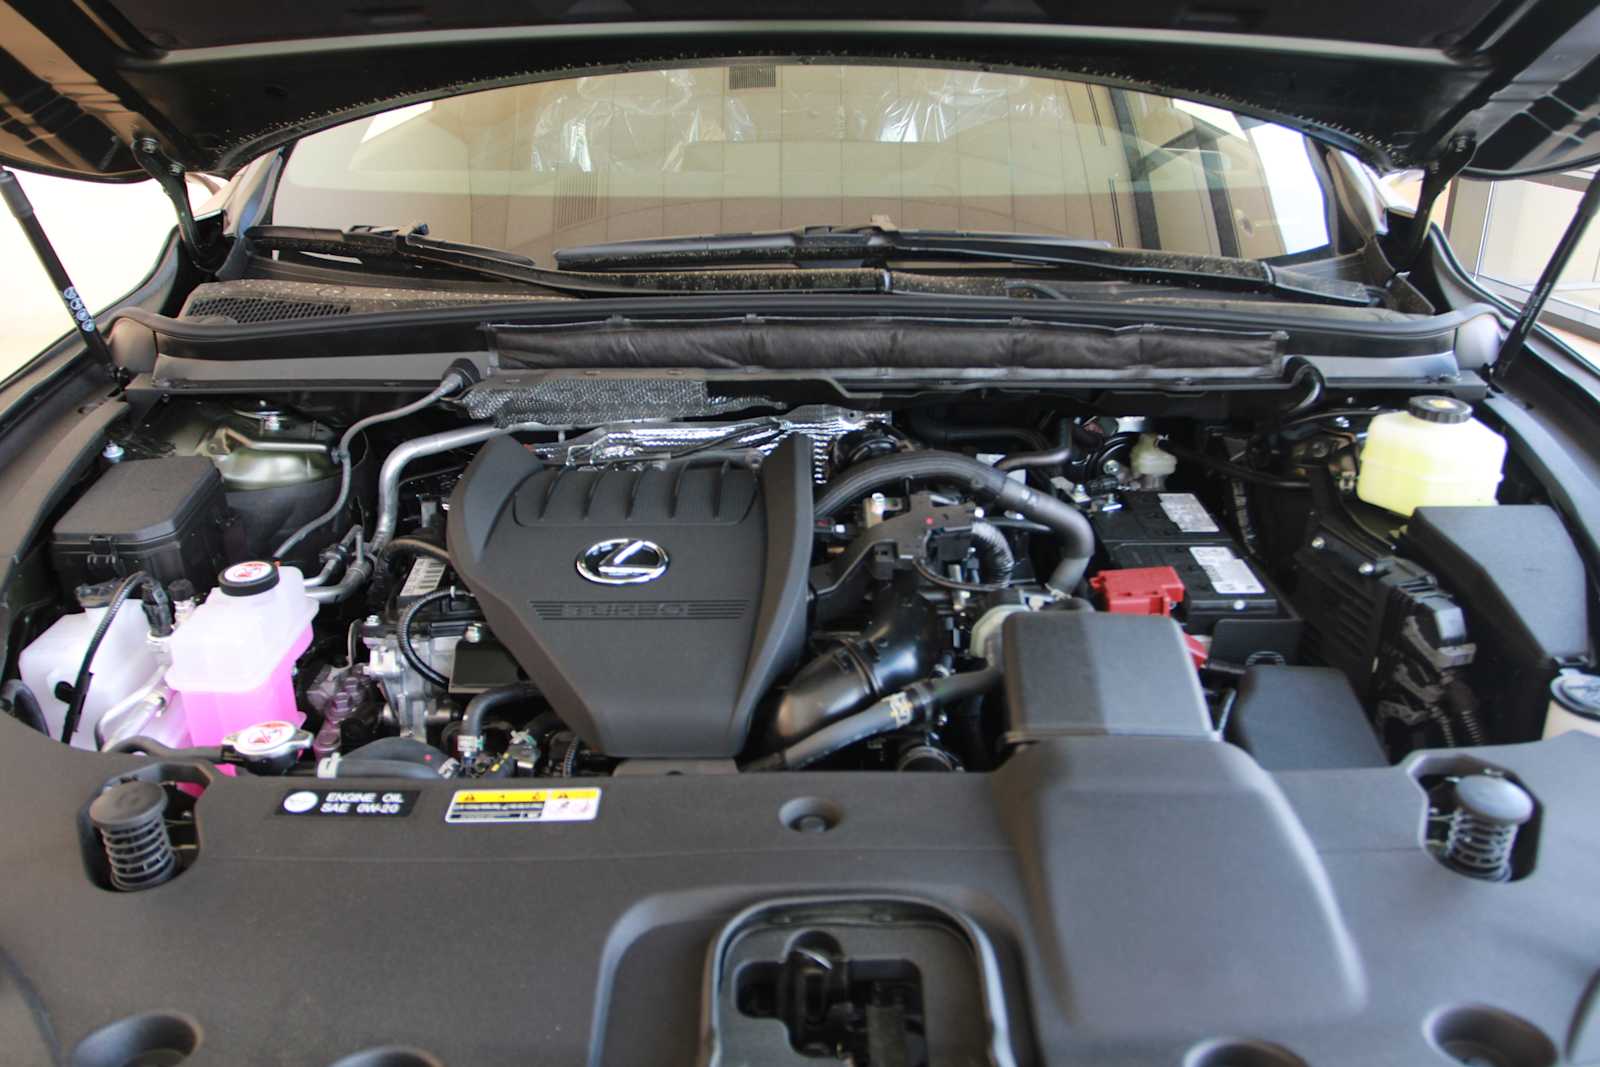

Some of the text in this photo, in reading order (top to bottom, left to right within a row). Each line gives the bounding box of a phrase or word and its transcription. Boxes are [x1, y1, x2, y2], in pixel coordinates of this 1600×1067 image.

[325, 792, 405, 803] ENGINE OIL
[320, 802, 351, 813] SAE
